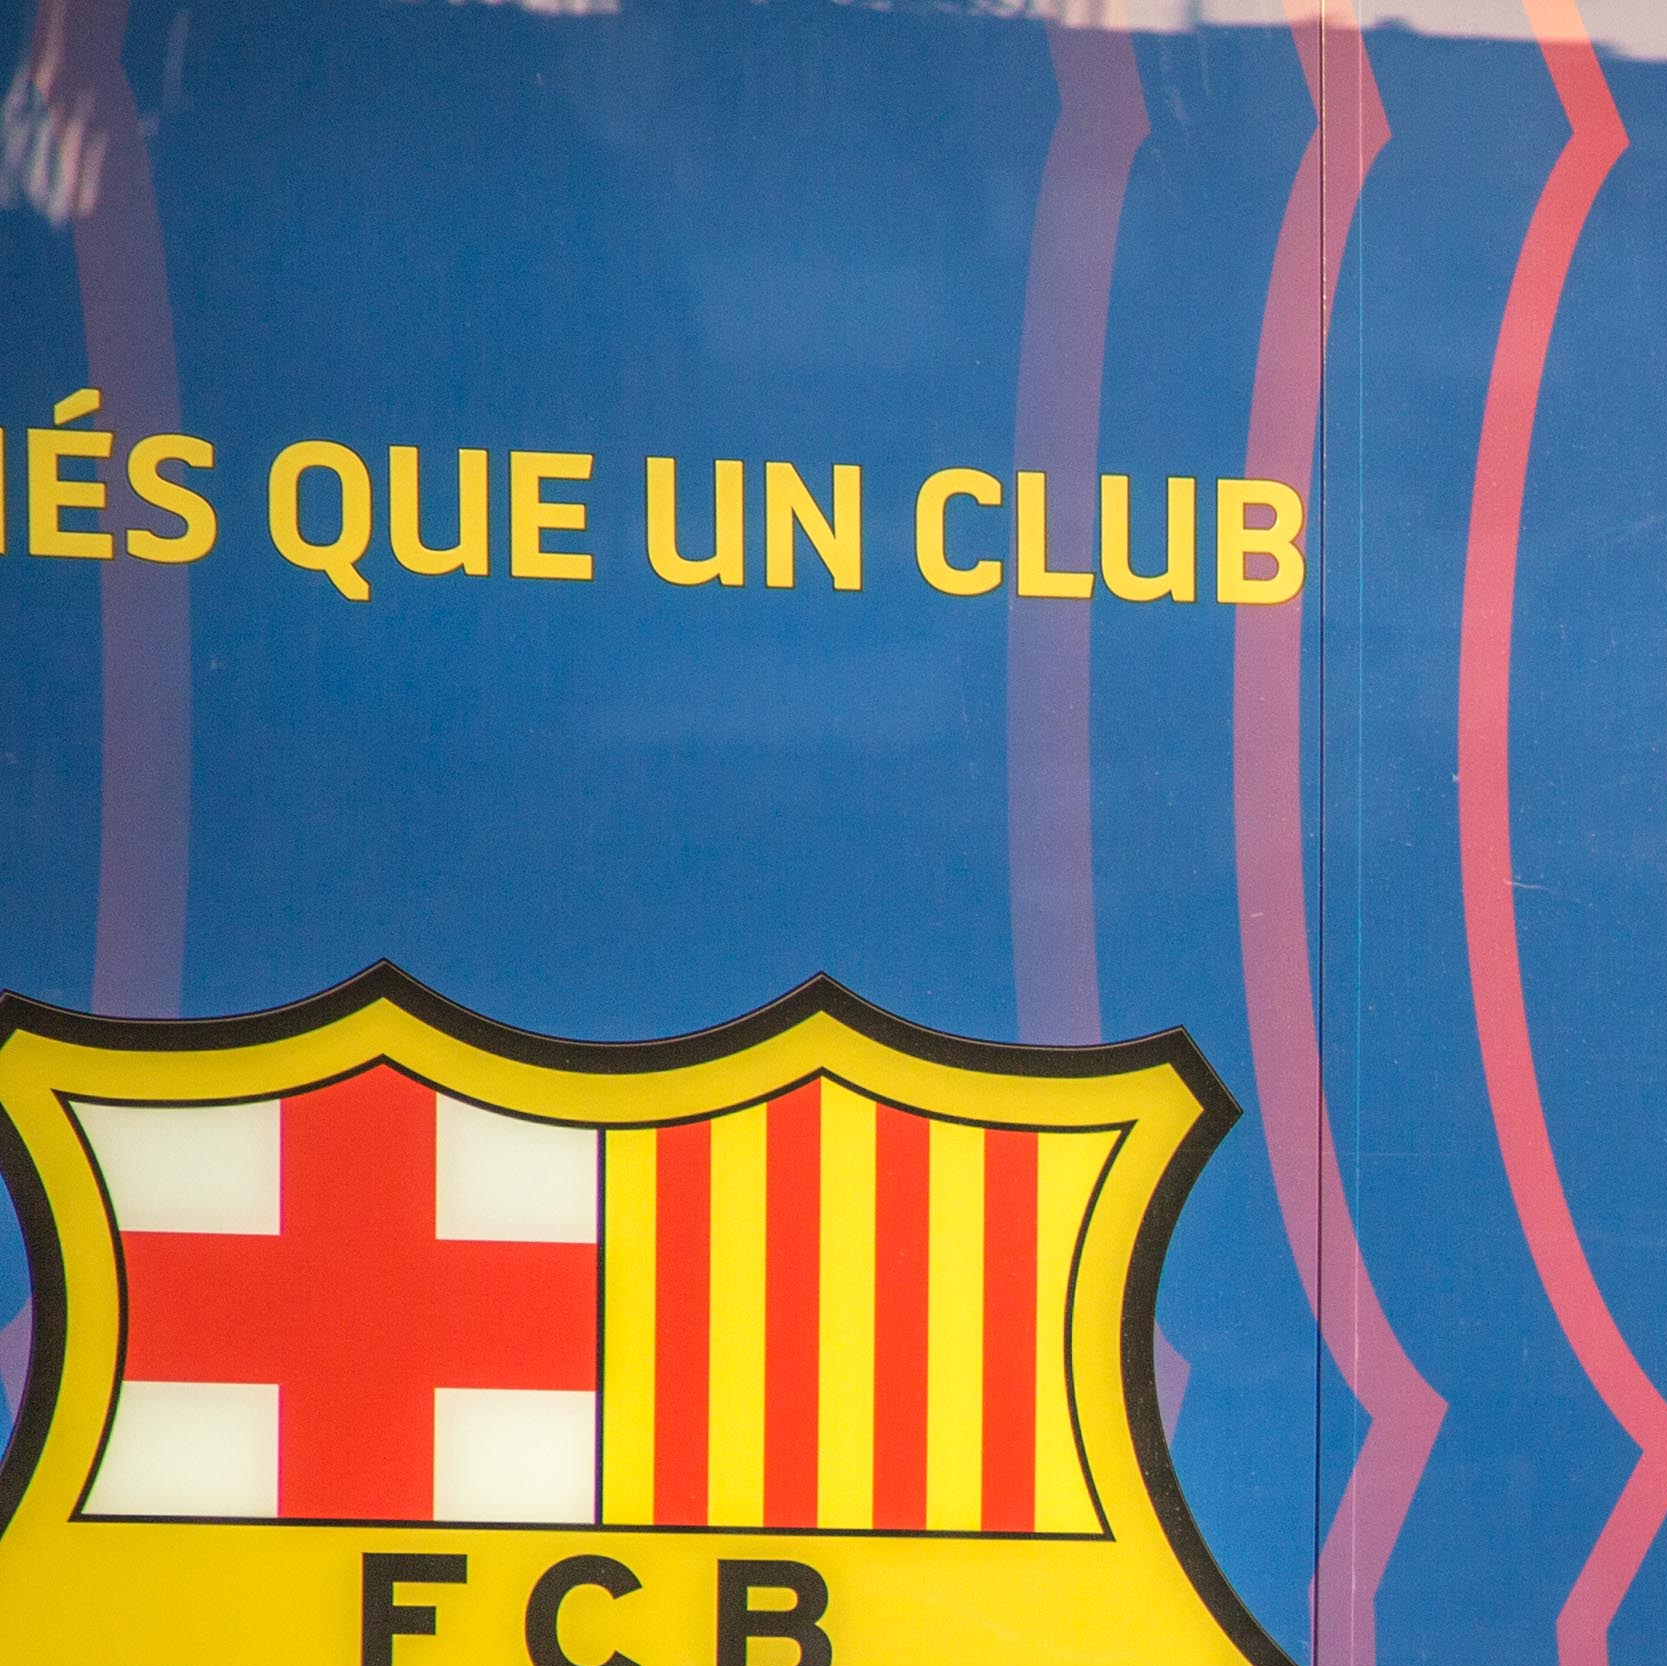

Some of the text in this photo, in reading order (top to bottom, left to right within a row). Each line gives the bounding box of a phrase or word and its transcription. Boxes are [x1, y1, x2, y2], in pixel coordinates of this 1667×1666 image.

[0, 385, 1307, 607] ÉS QUE UN CLUB
